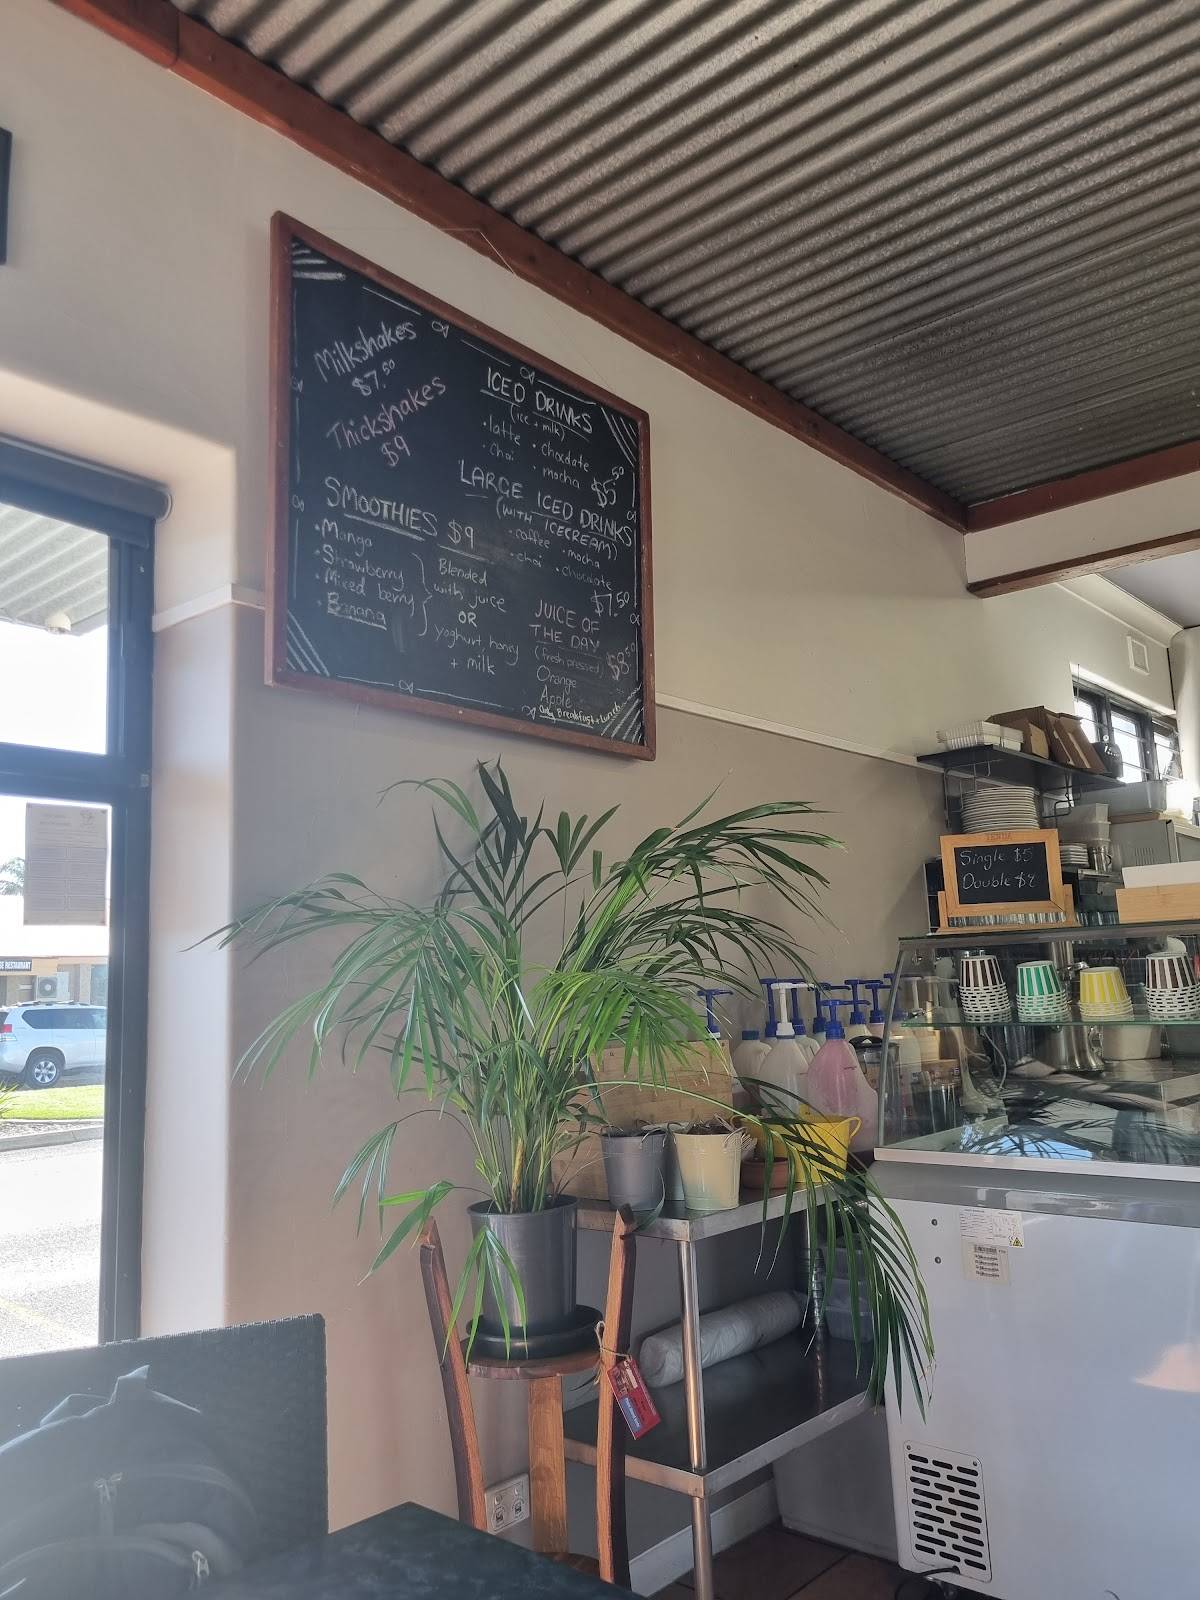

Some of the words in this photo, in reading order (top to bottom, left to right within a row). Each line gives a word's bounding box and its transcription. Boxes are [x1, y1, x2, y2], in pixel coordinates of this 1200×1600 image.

[314, 321, 417, 383] Milkshakes
[326, 376, 446, 450] Thickshakes
[487, 367, 526, 403] ICED
[535, 390, 593, 434] DRINKS
[381, 435, 411, 467] $9
[325, 476, 438, 537] SMOOTHIES
[447, 519, 475, 550] $9
[460, 459, 525, 499] LARGE
[537, 491, 574, 521] ICED
[579, 509, 633, 548] DRINKS
[439, 558, 488, 586] Blended
[378, 583, 415, 617] berry
[433, 583, 464, 600] with
[468, 595, 507, 613] juice
[458, 610, 477, 628] OR
[535, 600, 577, 629] JUICE
[581, 617, 600, 633] OF
[529, 624, 563, 643] THE
[570, 635, 600, 653] DAY
[467, 655, 496, 675] milk
[536, 665, 577, 693] Orange
[960, 848, 1005, 870] Single
[962, 872, 1011, 890] Double
